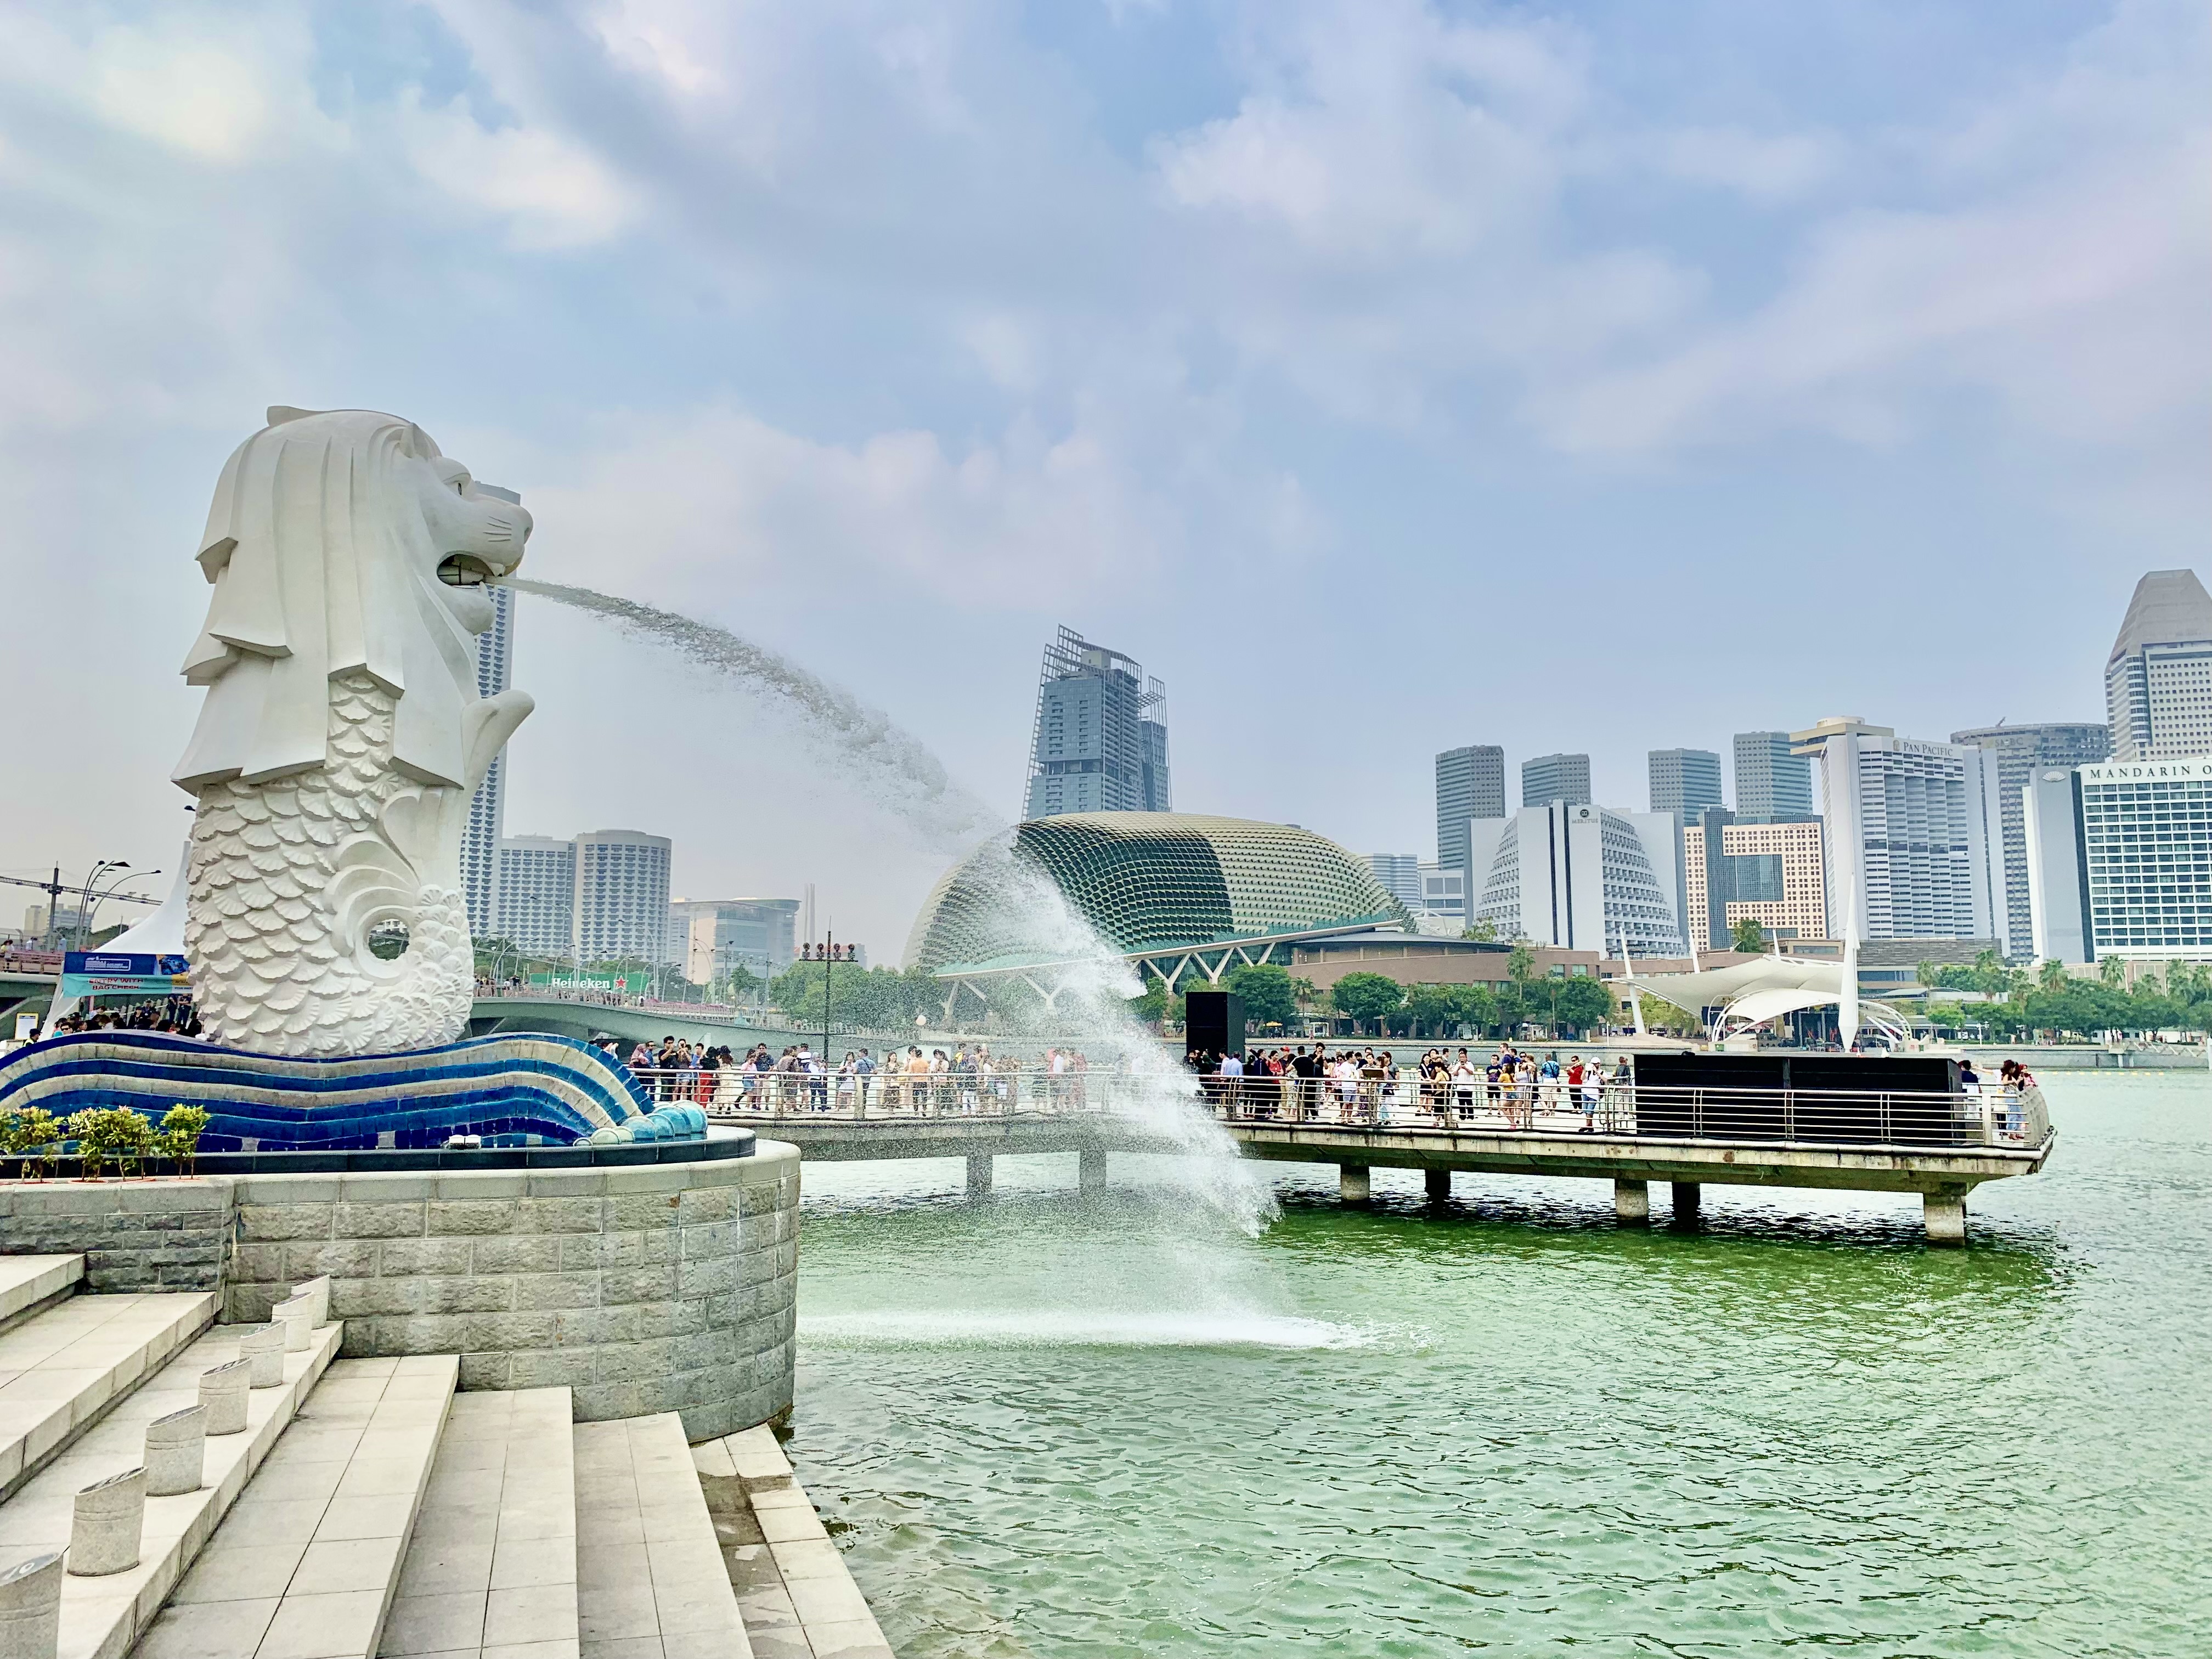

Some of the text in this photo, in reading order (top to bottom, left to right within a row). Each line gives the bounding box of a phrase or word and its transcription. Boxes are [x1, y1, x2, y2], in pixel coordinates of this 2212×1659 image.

[1904, 742, 1953, 756] PAN PACIFIC
[2091, 765, 2211, 778] MANDARIN O
